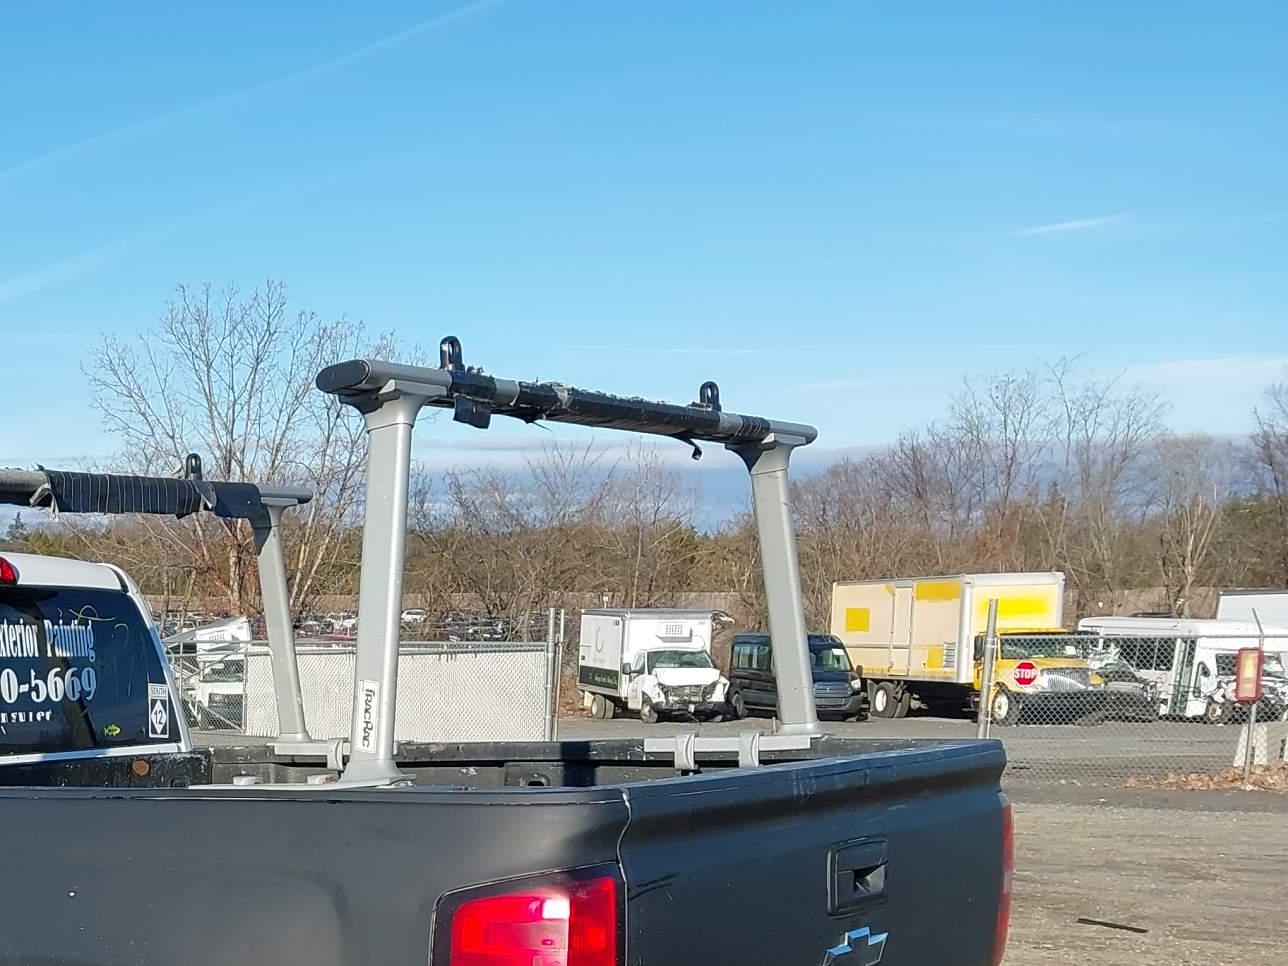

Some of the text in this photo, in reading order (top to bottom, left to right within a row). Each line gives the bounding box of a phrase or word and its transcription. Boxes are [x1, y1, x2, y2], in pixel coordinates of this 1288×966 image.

[44, 619, 96, 662] Painting
[1014, 668, 1037, 679] STOP
[151, 686, 167, 696] SOUTH
[154, 710, 163, 725] 12
